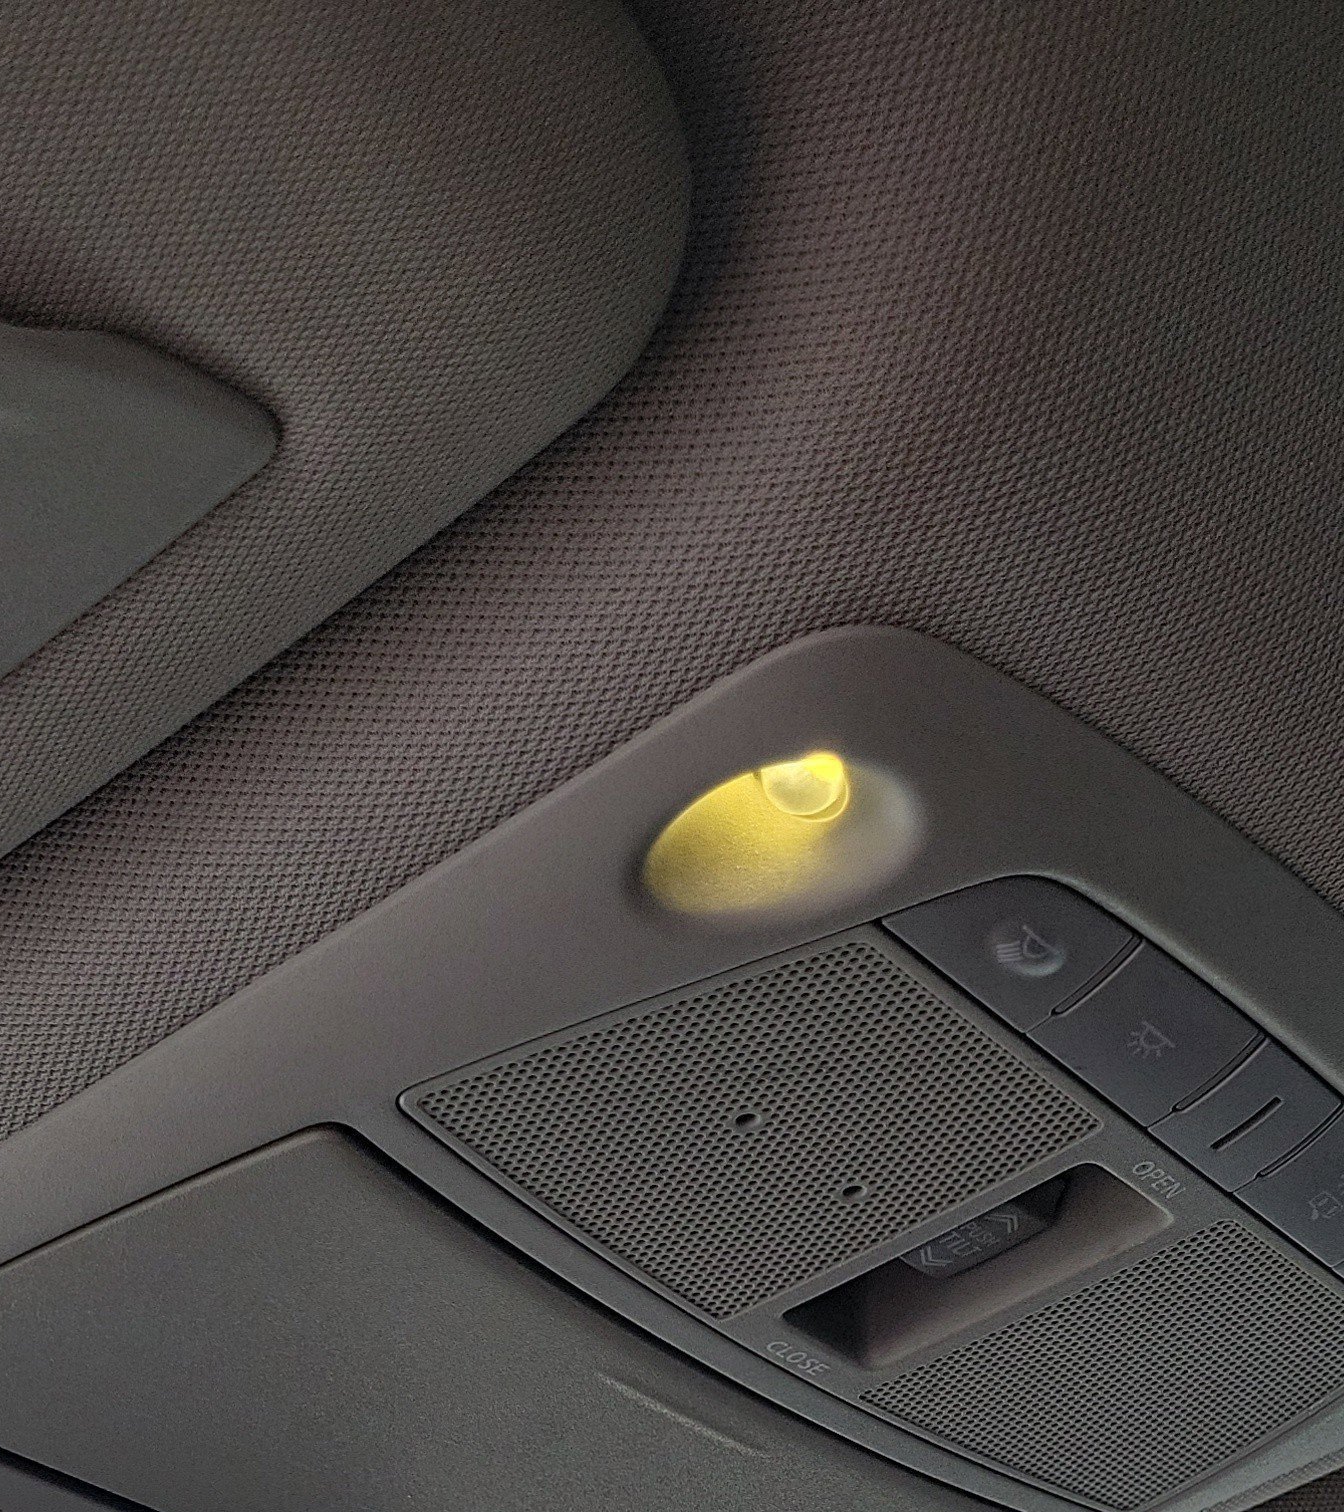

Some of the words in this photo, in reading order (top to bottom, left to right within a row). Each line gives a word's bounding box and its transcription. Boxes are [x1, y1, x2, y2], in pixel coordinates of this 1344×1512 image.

[1132, 1161, 1186, 1200] OPEN
[939, 1231, 982, 1257] TILT
[959, 1221, 1001, 1247] PUSH
[766, 1341, 831, 1376] CLOSE
